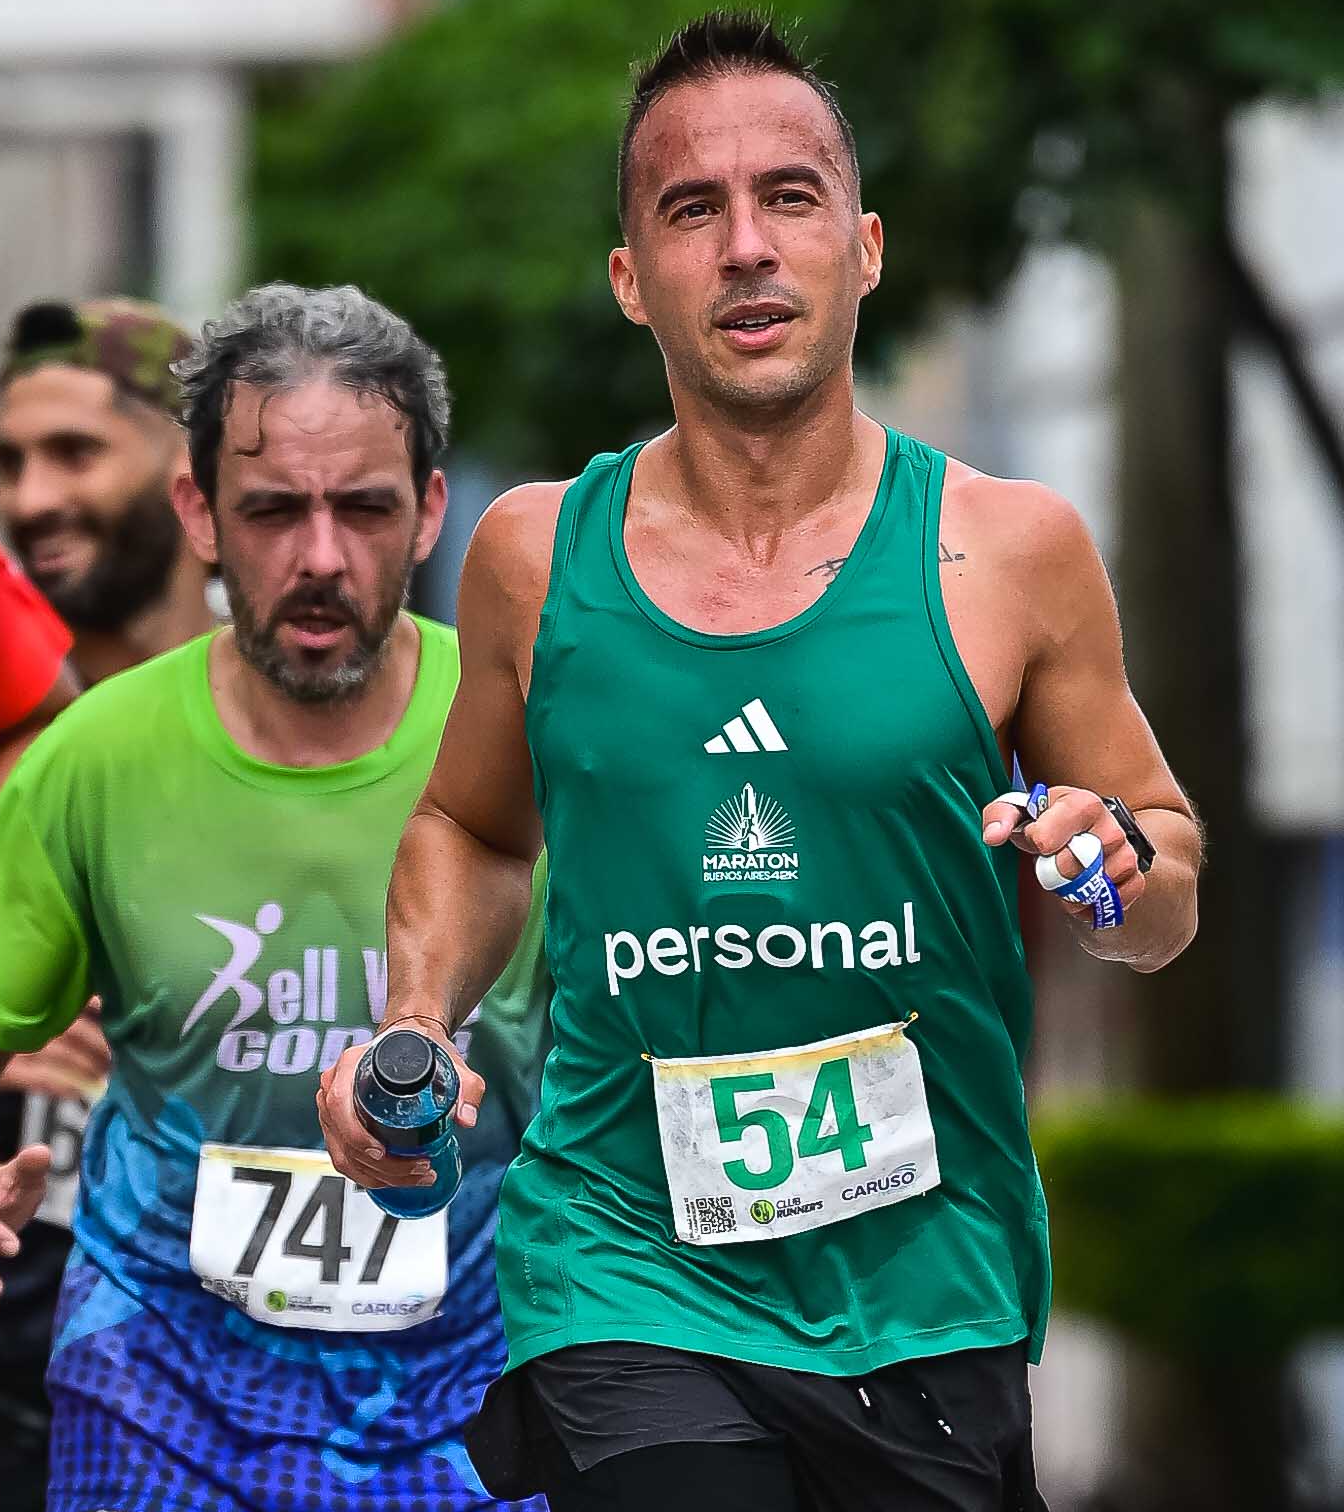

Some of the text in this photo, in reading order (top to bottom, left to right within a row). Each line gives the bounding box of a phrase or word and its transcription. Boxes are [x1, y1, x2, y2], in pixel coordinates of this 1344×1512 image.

[702, 852, 799, 870] MARATON
[703, 871, 743, 882] BUENOS
[603, 901, 921, 996] personal
[709, 1057, 874, 1191] 54
[841, 1171, 915, 1201] CARUSO
[776, 1197, 801, 1209] CLUB
